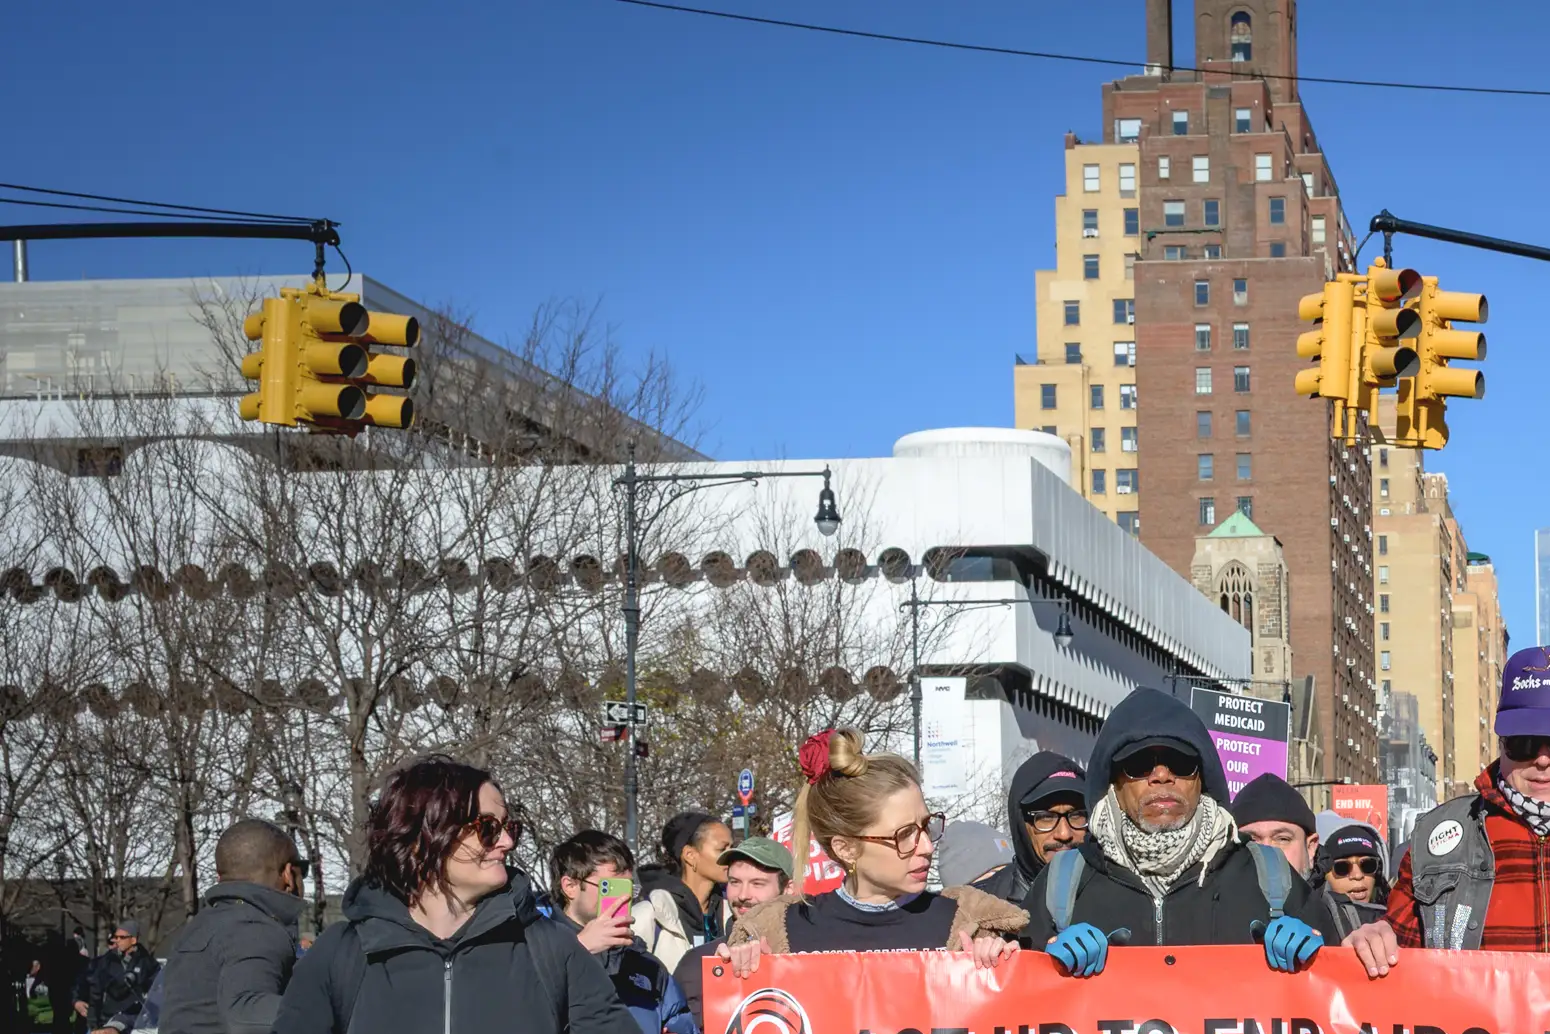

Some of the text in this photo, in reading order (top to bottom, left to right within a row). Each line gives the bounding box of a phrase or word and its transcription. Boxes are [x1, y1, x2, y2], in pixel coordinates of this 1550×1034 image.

[1512, 675, 1540, 691] Socks
[1543, 678, 1550, 686] on
[1218, 696, 1263, 714] PROTECT
[1215, 713, 1265, 731] MEDICAID
[1216, 738, 1261, 755] PROTECT
[1227, 760, 1248, 774] OUR
[1335, 799, 1374, 809] END HIV.
[1431, 826, 1457, 844] FIGHT
